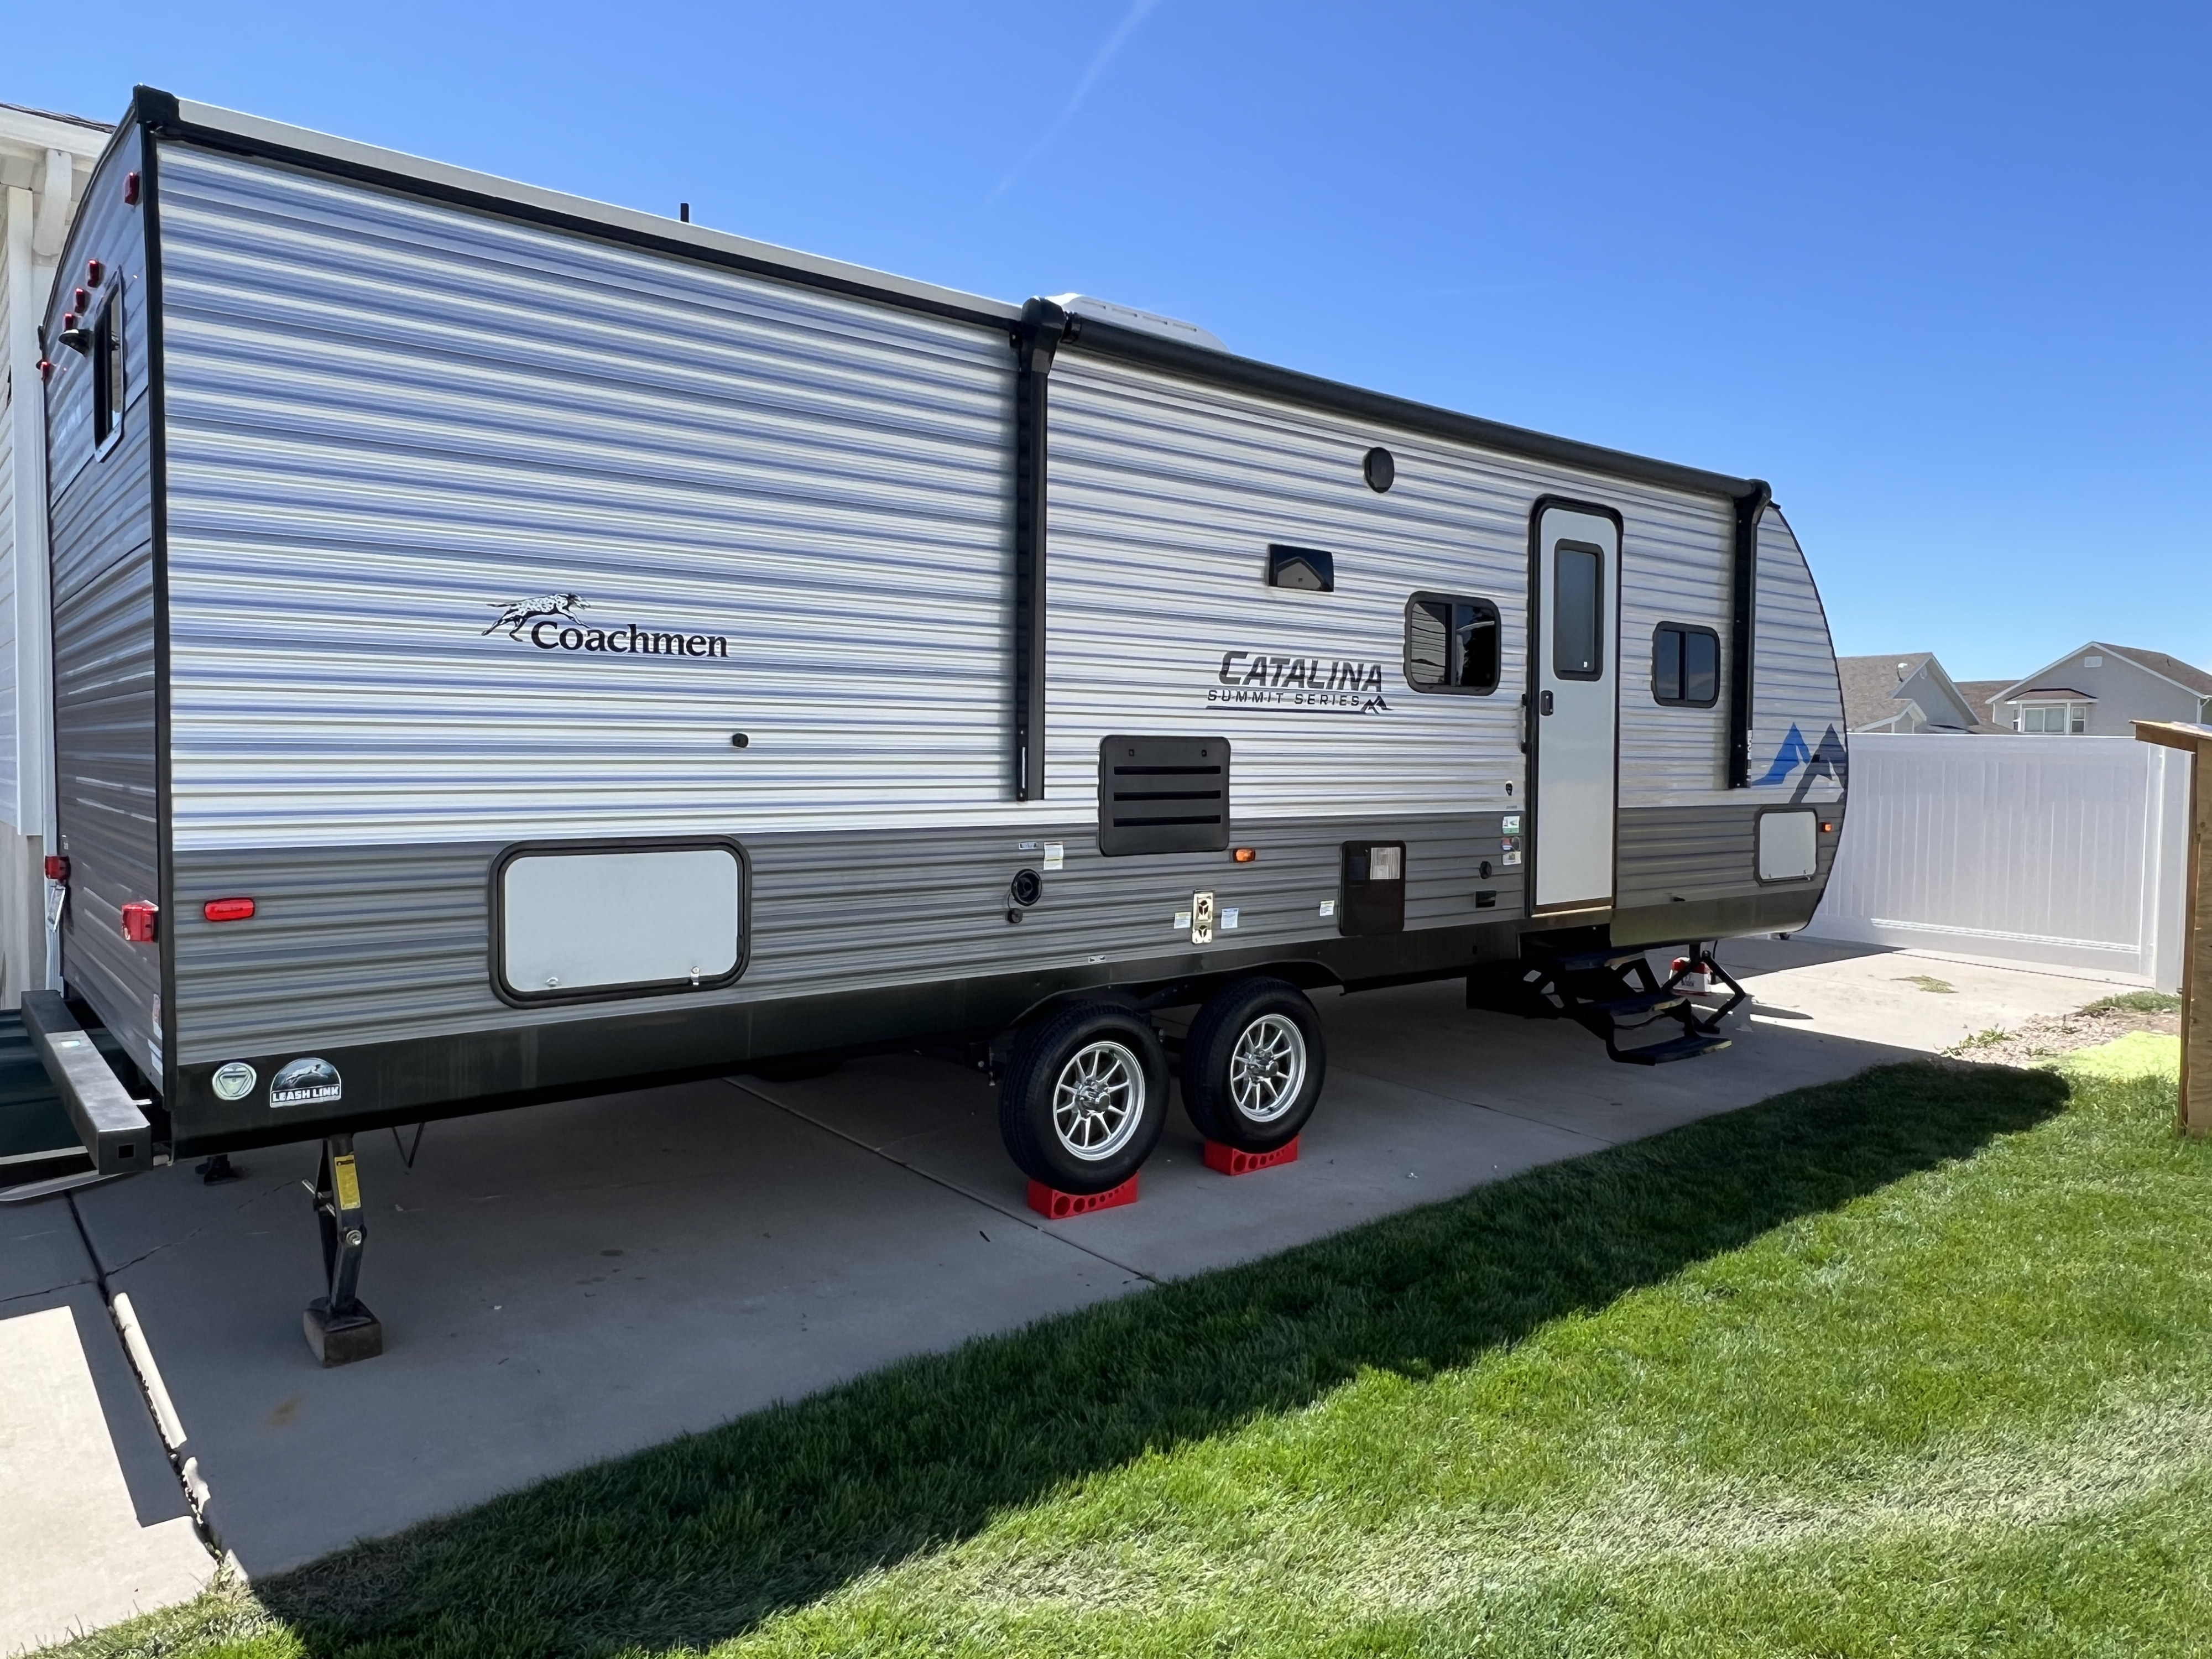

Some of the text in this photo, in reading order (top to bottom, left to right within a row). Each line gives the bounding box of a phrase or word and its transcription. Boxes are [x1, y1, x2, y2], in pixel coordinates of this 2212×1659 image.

[531, 621, 730, 658] Coachmen
[1219, 651, 1382, 692] CATALINA
[1208, 690, 1360, 706] SUMMIT SERIES
[272, 1086, 339, 1102] LEASH LINK
